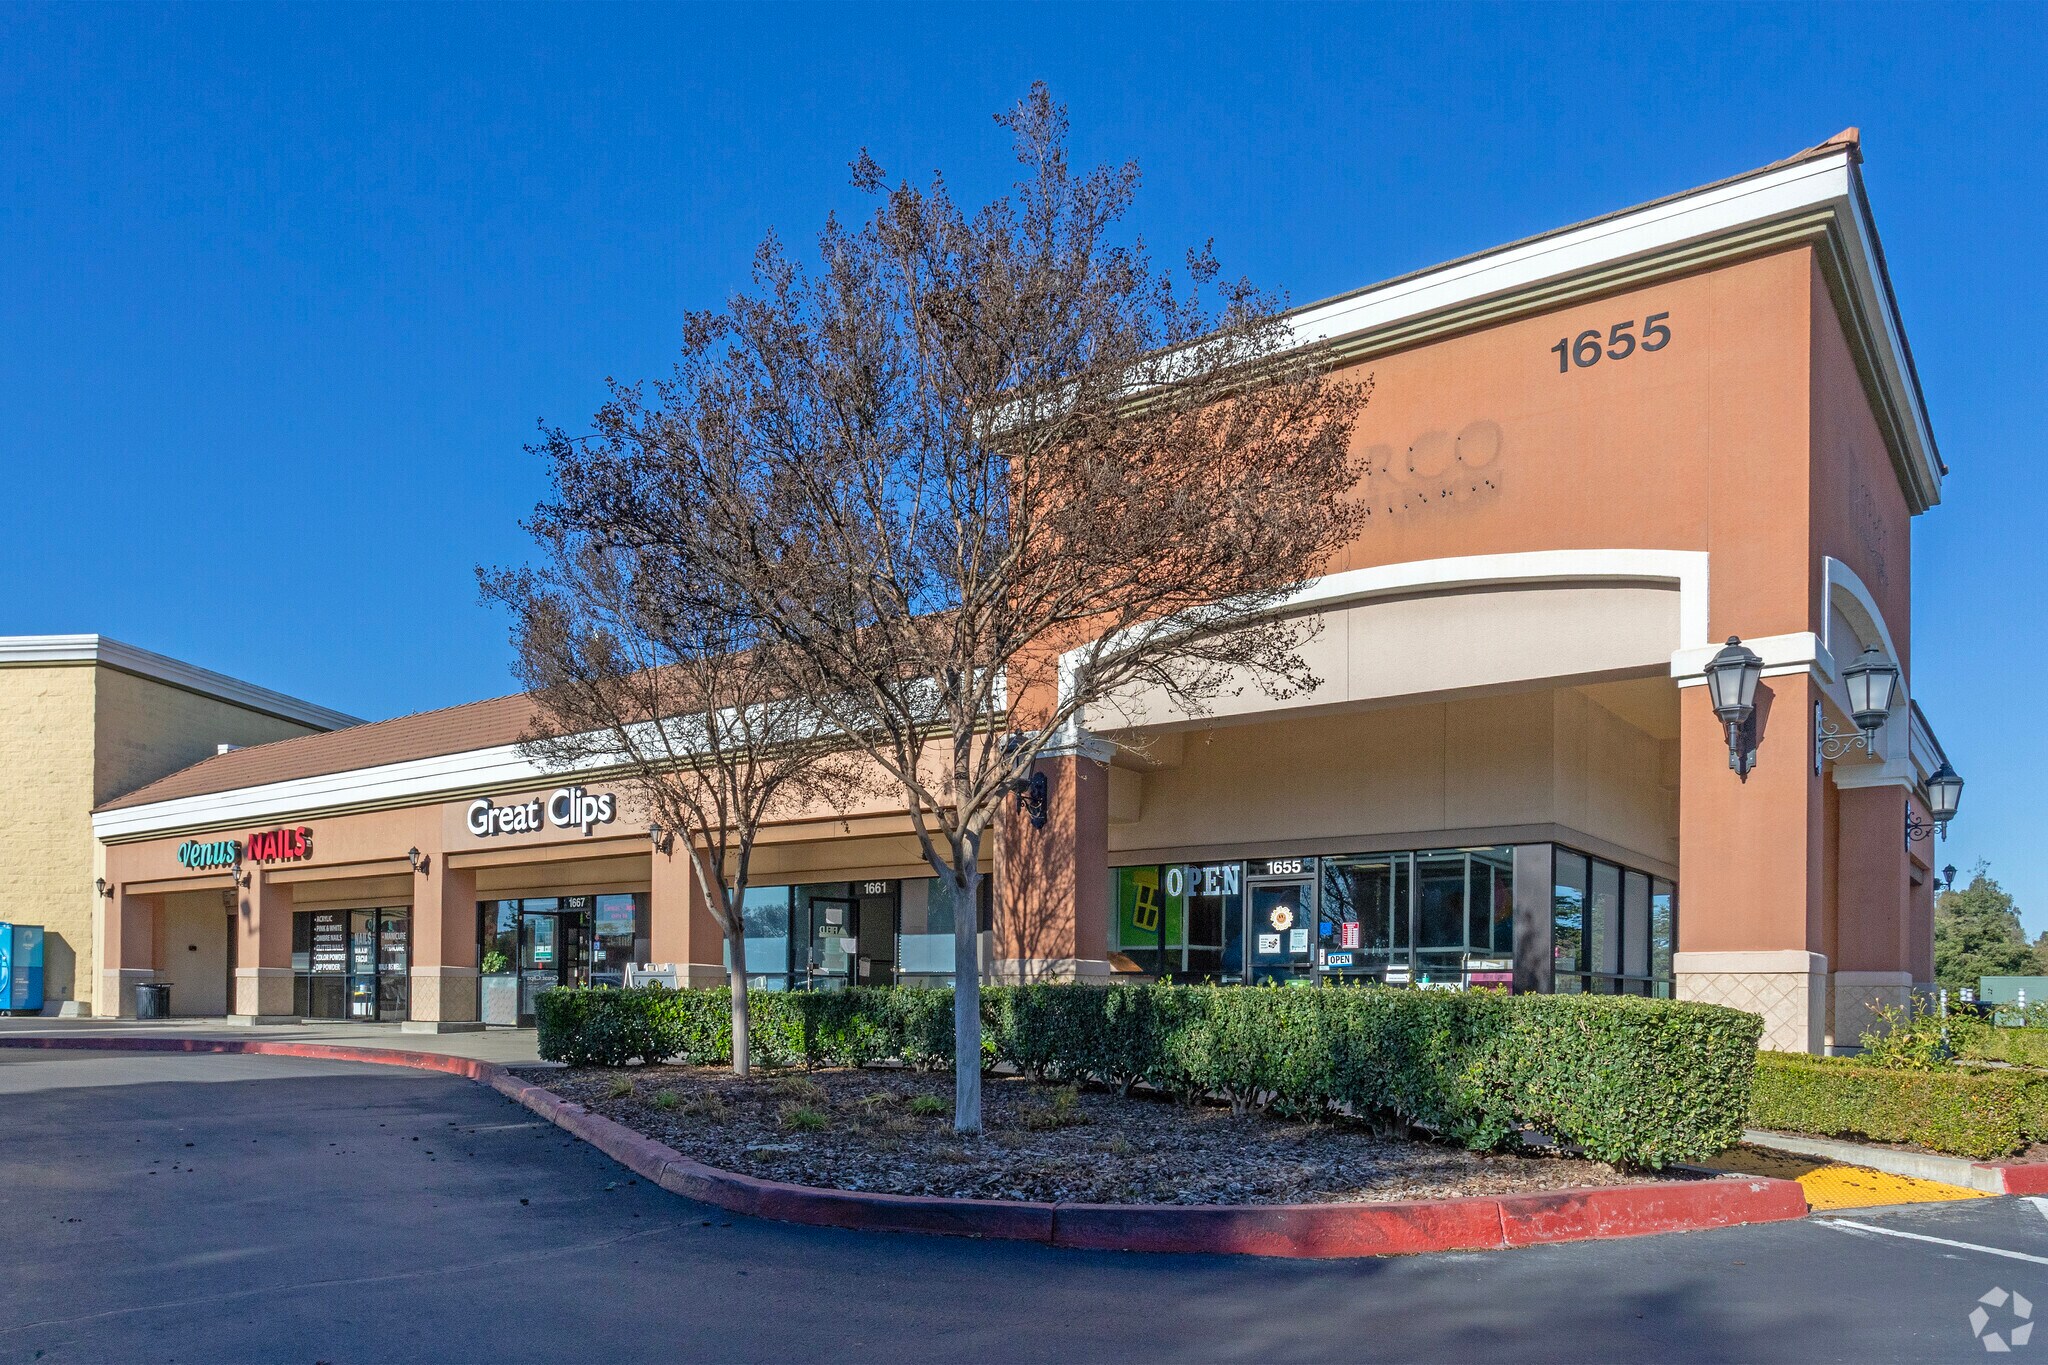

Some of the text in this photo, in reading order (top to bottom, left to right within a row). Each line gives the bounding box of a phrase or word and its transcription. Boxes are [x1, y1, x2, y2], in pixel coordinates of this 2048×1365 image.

[1551, 311, 1671, 374] 1655
[467, 786, 612, 836] Great Clips
[177, 826, 306, 868] Venus NAILS
[1266, 860, 1302, 875] 1655
[1167, 864, 1241, 897] OPEN
[864, 882, 887, 894] 1661
[568, 897, 586, 908] 1667
[355, 931, 372, 945] NAILS
[384, 932, 407, 940] MANICURE
[1330, 955, 1350, 964] OPEN
